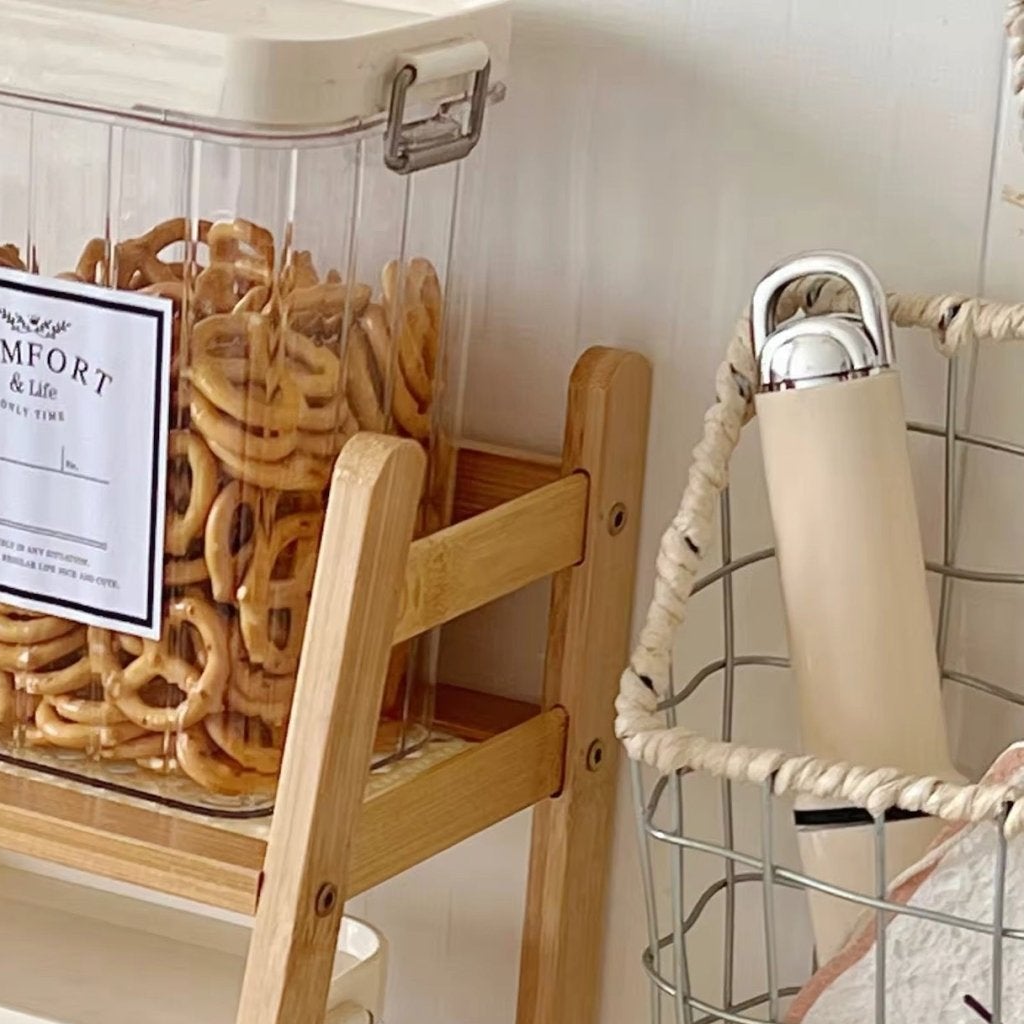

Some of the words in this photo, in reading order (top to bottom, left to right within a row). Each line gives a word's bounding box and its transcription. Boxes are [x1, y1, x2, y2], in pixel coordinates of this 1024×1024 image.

[9, 371, 24, 394] &
[29, 378, 58, 400] Life
[0, 398, 29, 417] ONLY
[34, 410, 65, 422] TIME
